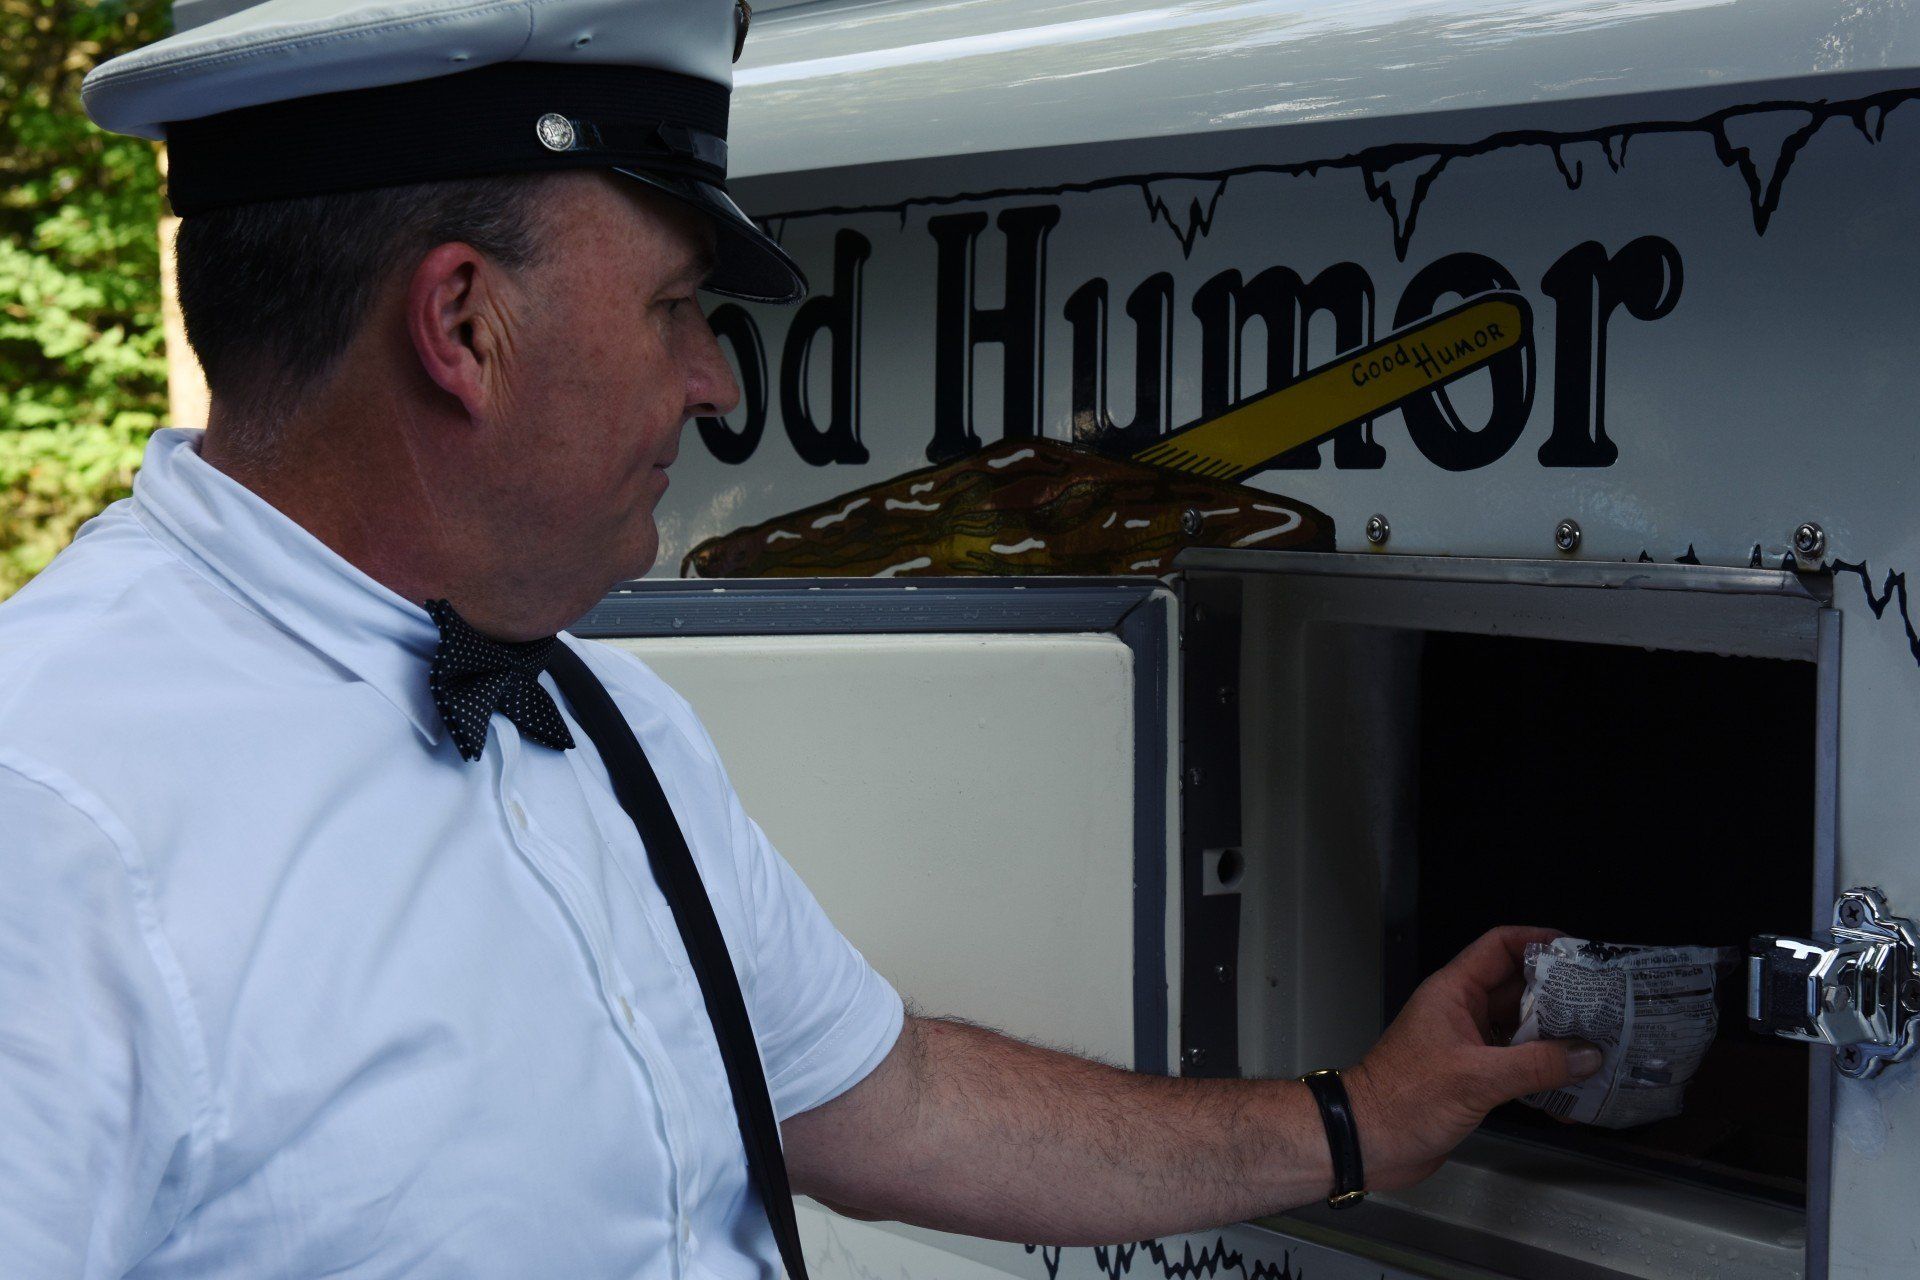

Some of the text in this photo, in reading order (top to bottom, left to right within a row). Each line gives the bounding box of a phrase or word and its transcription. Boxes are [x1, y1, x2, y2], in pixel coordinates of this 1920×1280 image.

[695, 204, 1683, 471] od Humor
[1352, 344, 1410, 387] Good
